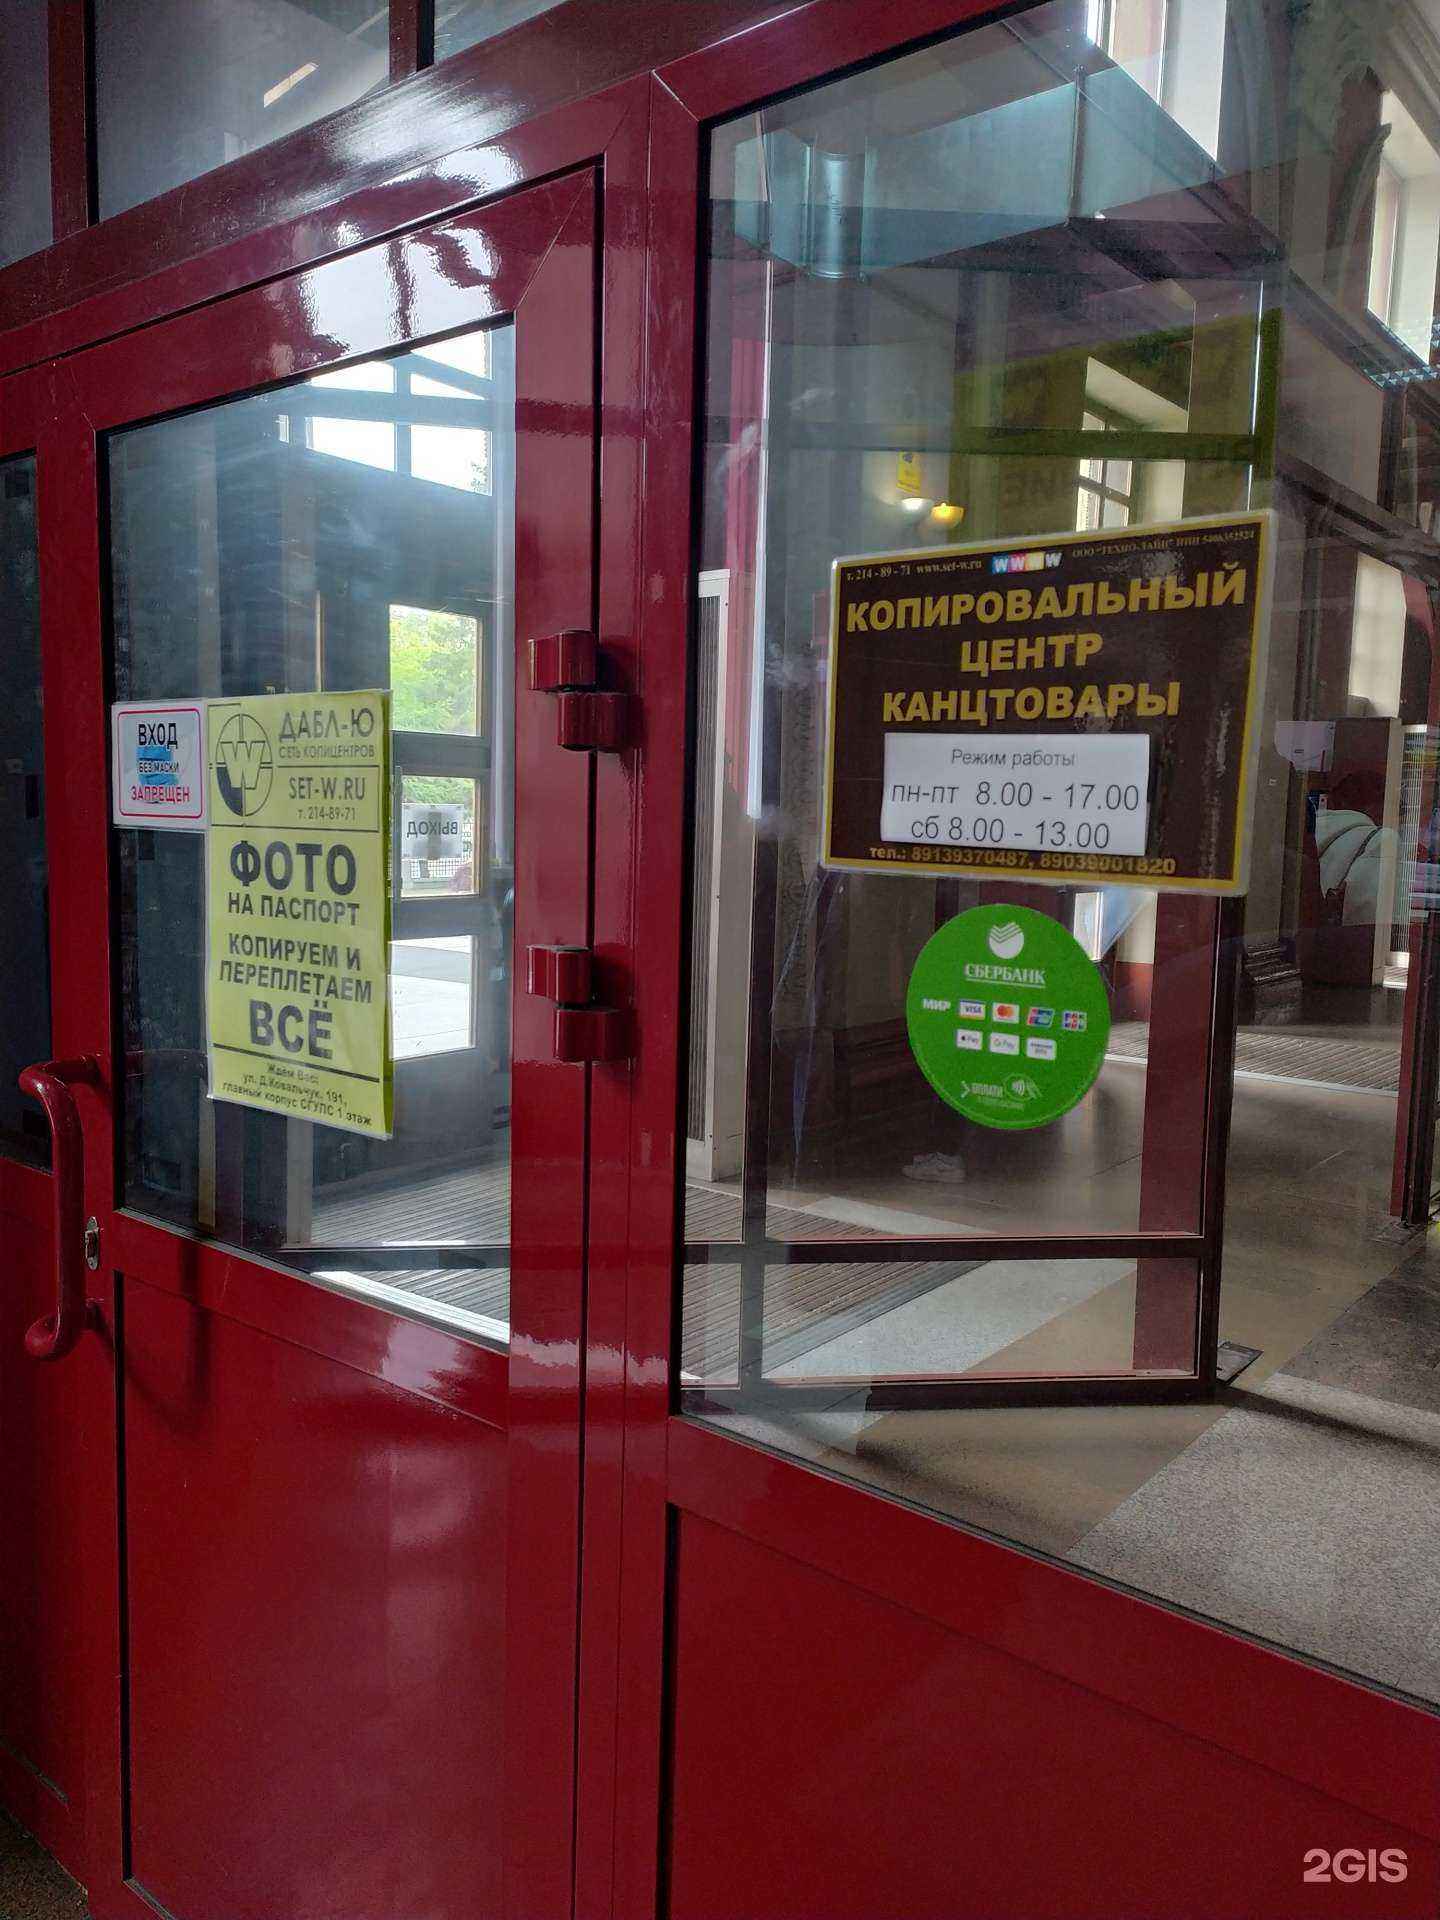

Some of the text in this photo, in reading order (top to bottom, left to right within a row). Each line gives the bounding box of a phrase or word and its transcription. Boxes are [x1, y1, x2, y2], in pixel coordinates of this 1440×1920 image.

[846, 561, 1248, 633] КОПИРОВАЛЬНЫЙ
[960, 634, 1103, 677] ЦЕНТР
[882, 681, 1182, 727] КАНЦТОВАРЫ
[137, 722, 178, 750] ВХОД
[279, 707, 375, 743] ДАБЛ-Ю
[138, 760, 179, 774] БЕЗ МАСКИ
[951, 748, 1076, 768] Режим работы
[130, 785, 190, 804] ЗАПРЕЩЕН
[288, 776, 366, 801] SET-W.RU
[891, 784, 960, 804] пн-пт
[975, 781, 1033, 808] 8.00
[1064, 783, 1140, 812] 17.00
[911, 816, 939, 840] сб
[947, 817, 1005, 844] 8.00
[1034, 821, 1111, 850] 13.00
[230, 840, 357, 896] ФОТО
[228, 891, 360, 927] НА ПАСПОРТ
[229, 932, 361, 971] КОПИРУЕМ И
[219, 959, 373, 1005] ПЕРЕПЛЕТАЕМ
[965, 963, 1045, 984] СБЕРБАНК
[923, 998, 951, 1012] МИР
[248, 998, 334, 1061] ВСЁ
[265, 1091, 298, 1110] корпус
[300, 1100, 335, 1117] СГУПС
[346, 1112, 373, 1127] этаж
